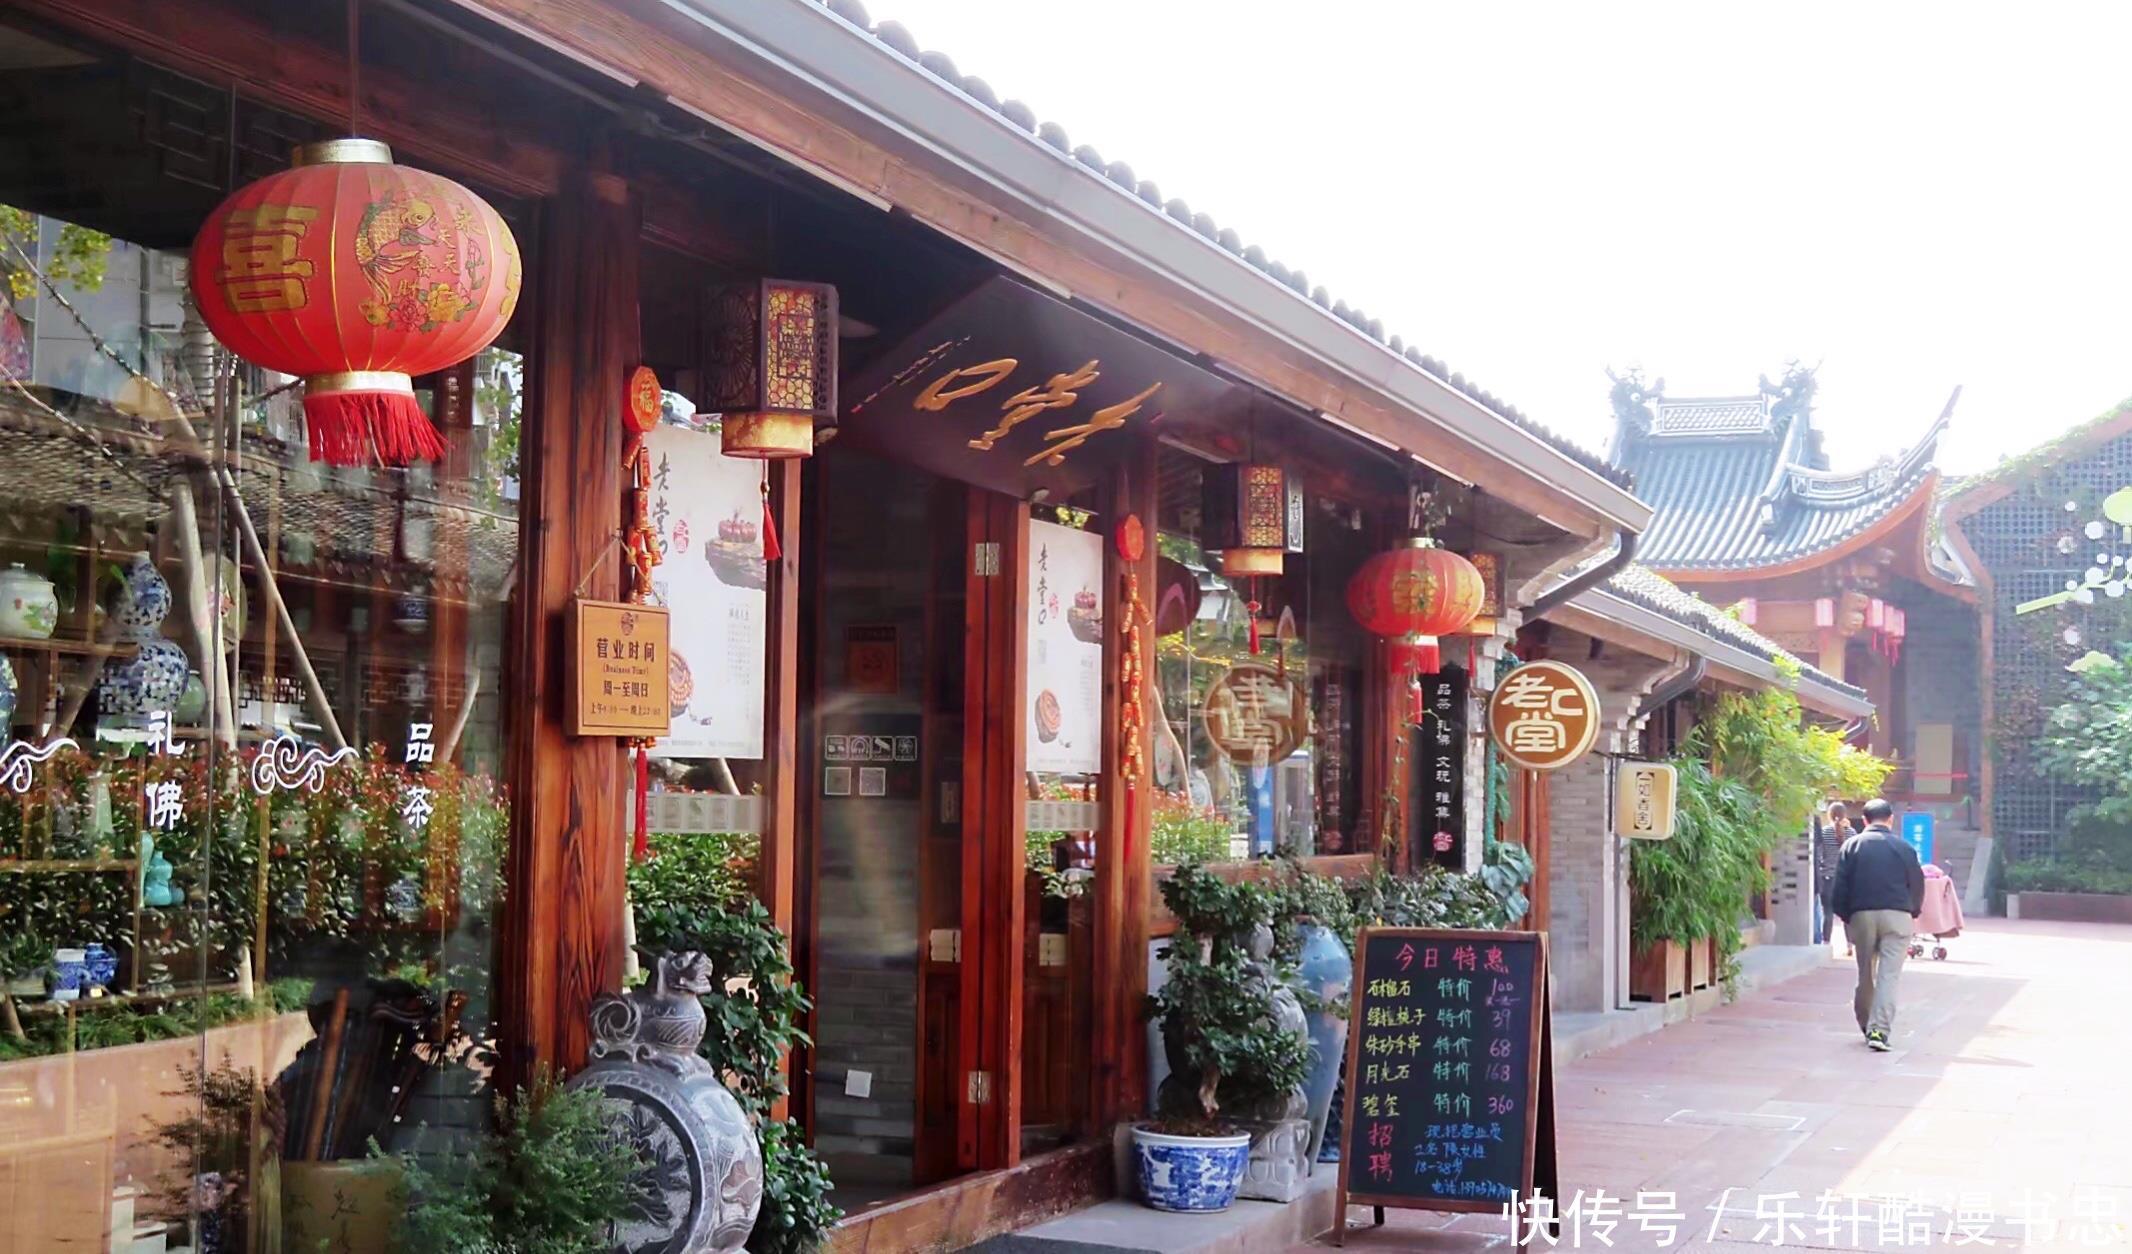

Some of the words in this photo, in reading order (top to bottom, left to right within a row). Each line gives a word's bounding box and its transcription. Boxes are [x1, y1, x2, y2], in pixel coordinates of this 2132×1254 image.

[597, 638, 655, 662] 营业时间
[604, 680, 648, 697] 周一至周日
[146, 711, 185, 830] 礼佛
[403, 723, 435, 829] 品茶
[1395, 943, 1509, 974] 今日特惠
[1438, 978, 1472, 1002] 特价
[1492, 978, 1514, 996] 100
[1437, 1009, 1472, 1029] 特价
[1493, 1009, 1511, 1031] 39
[1433, 1036, 1472, 1057] 特价
[1490, 1039, 1511, 1057] 68
[1366, 1061, 1410, 1084] 月光石
[1433, 1061, 1471, 1084] 特价
[1485, 1064, 1511, 1081] 168
[1433, 1092, 1471, 1118] 特价
[1488, 1094, 1514, 1115] 360
